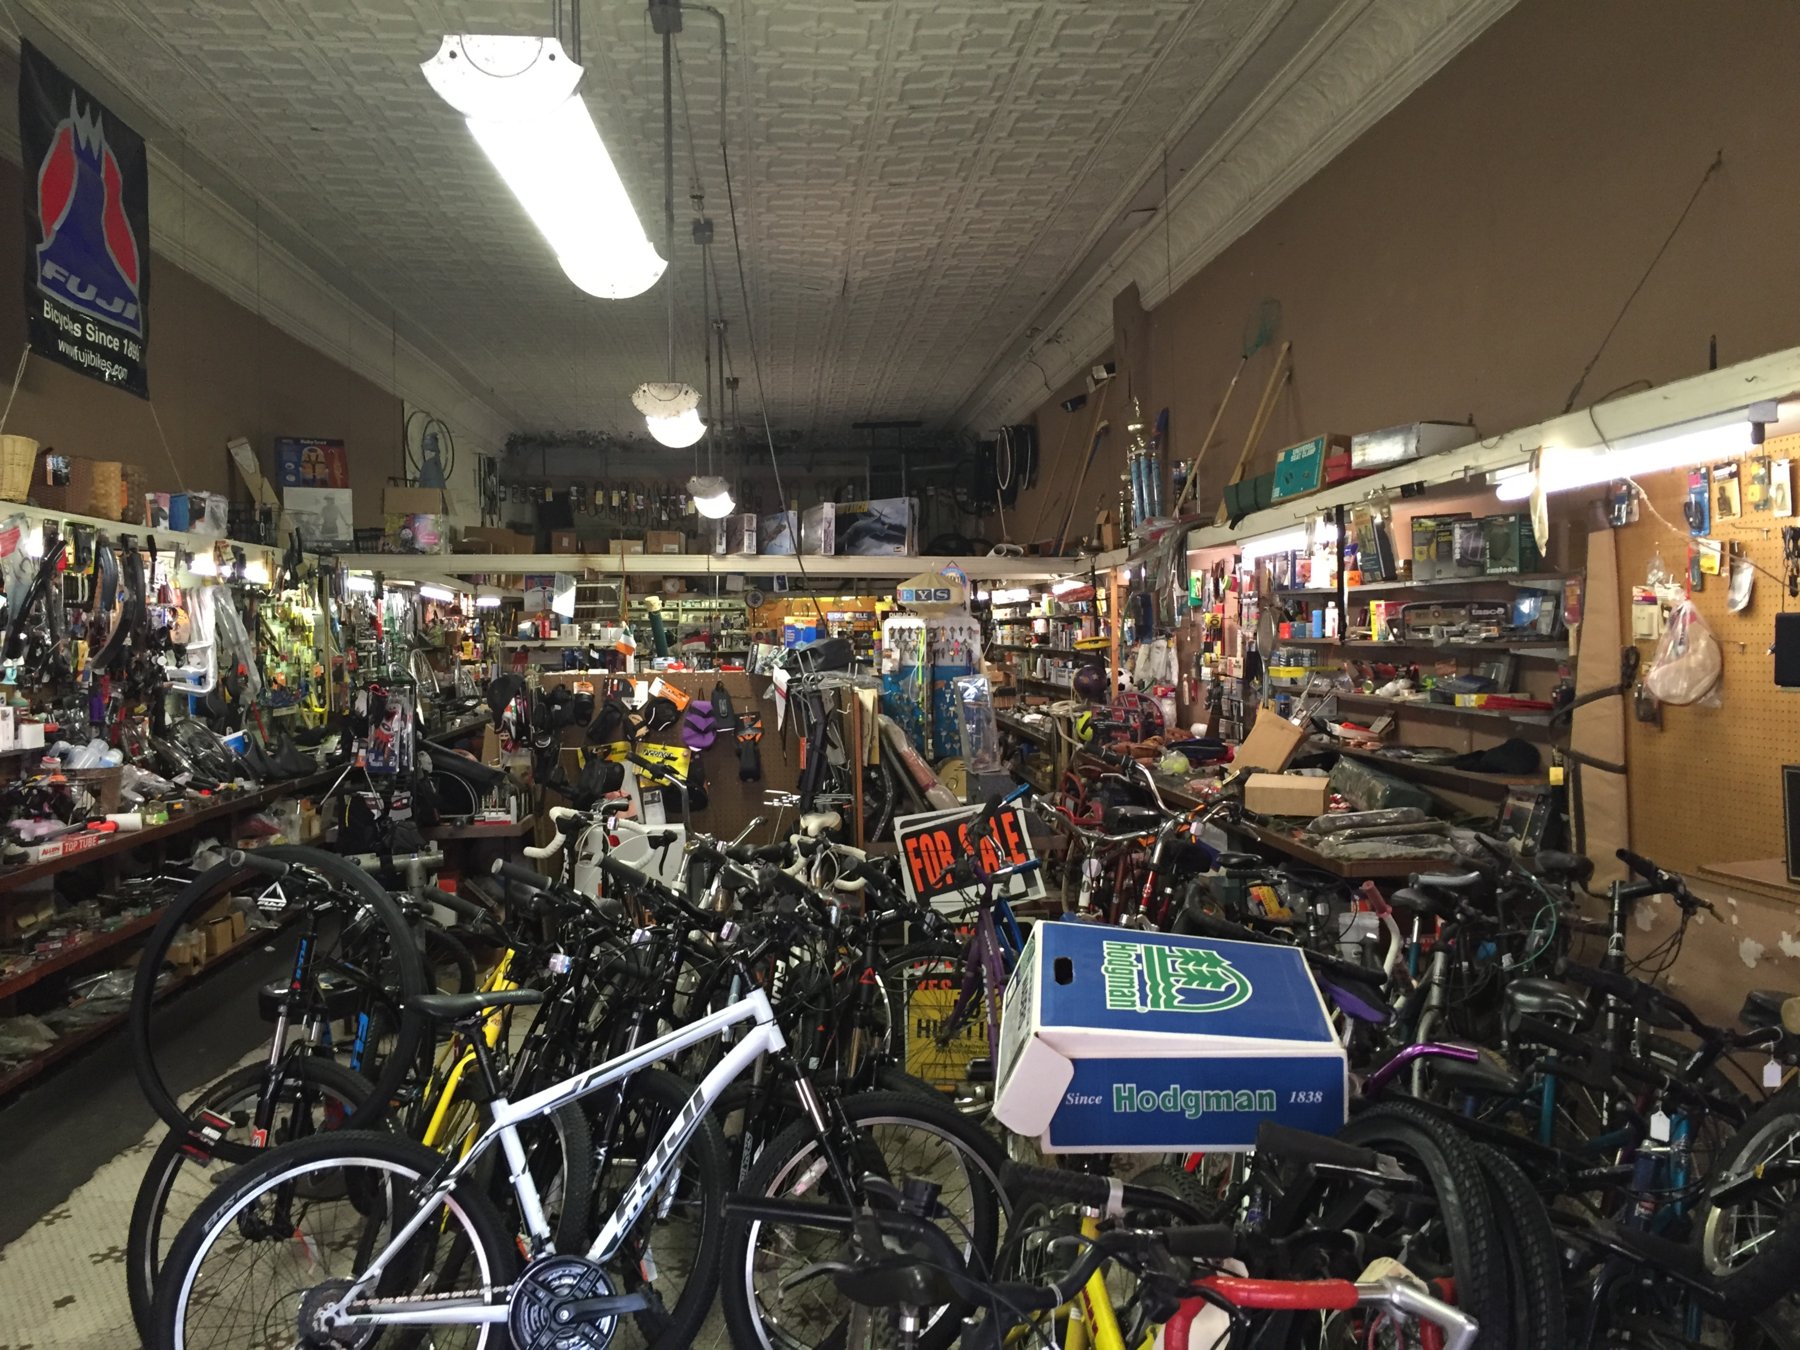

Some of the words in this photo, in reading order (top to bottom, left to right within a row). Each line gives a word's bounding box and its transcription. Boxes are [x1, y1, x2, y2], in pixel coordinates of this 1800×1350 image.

[41, 259, 138, 320] FUJI
[43, 299, 82, 338] Bicycles
[86, 322, 120, 352] Since
[1487, 566, 1518, 575] canteen
[64, 841, 79, 852] TOP
[79, 836, 98, 849] TUBE
[904, 830, 956, 894] FOR
[957, 811, 1027, 874] SALE
[1102, 940, 1142, 1011] Hodgman
[1065, 1092, 1103, 1106] Since
[1112, 1083, 1277, 1120] Hodgman
[1288, 1090, 1324, 1104] 1838
[615, 1085, 706, 1224] FUJI
